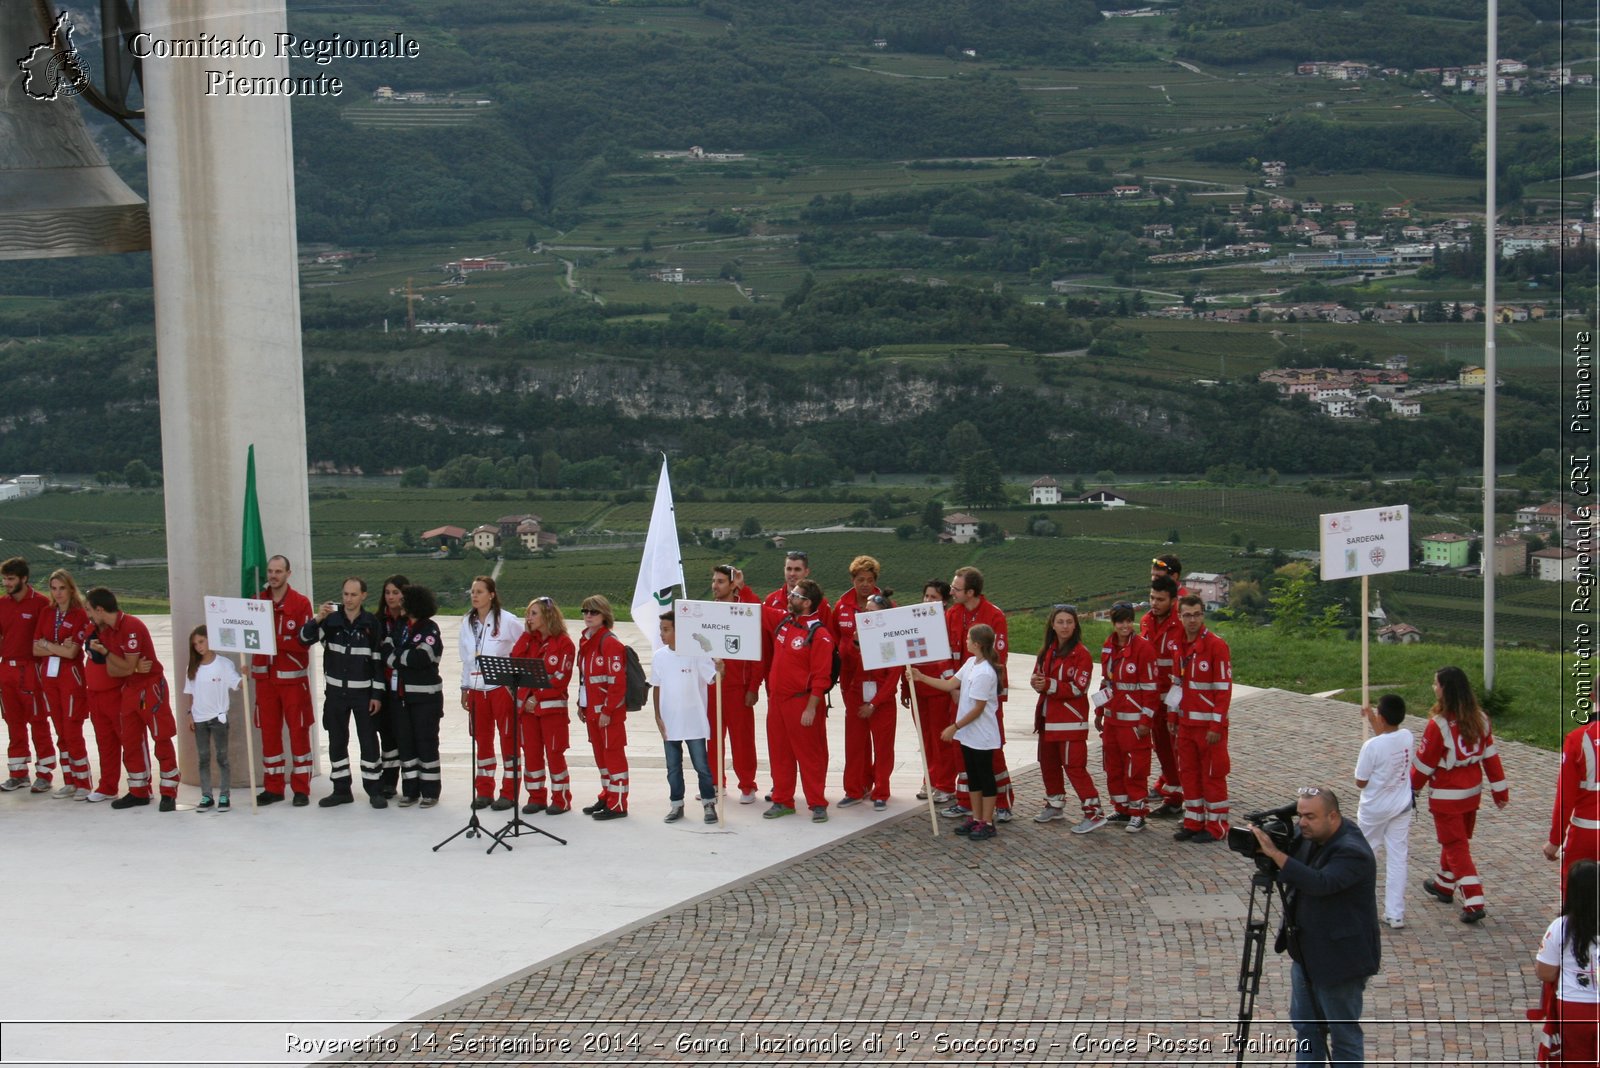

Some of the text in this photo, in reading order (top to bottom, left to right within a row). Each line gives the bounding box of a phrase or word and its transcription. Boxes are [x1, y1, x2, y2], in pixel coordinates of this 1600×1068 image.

[1346, 534, 1385, 545] SARDEGNA
[222, 618, 254, 626] LOMBARDIA
[701, 623, 731, 631] MARCHE
[883, 627, 919, 638] PIEMONTE
